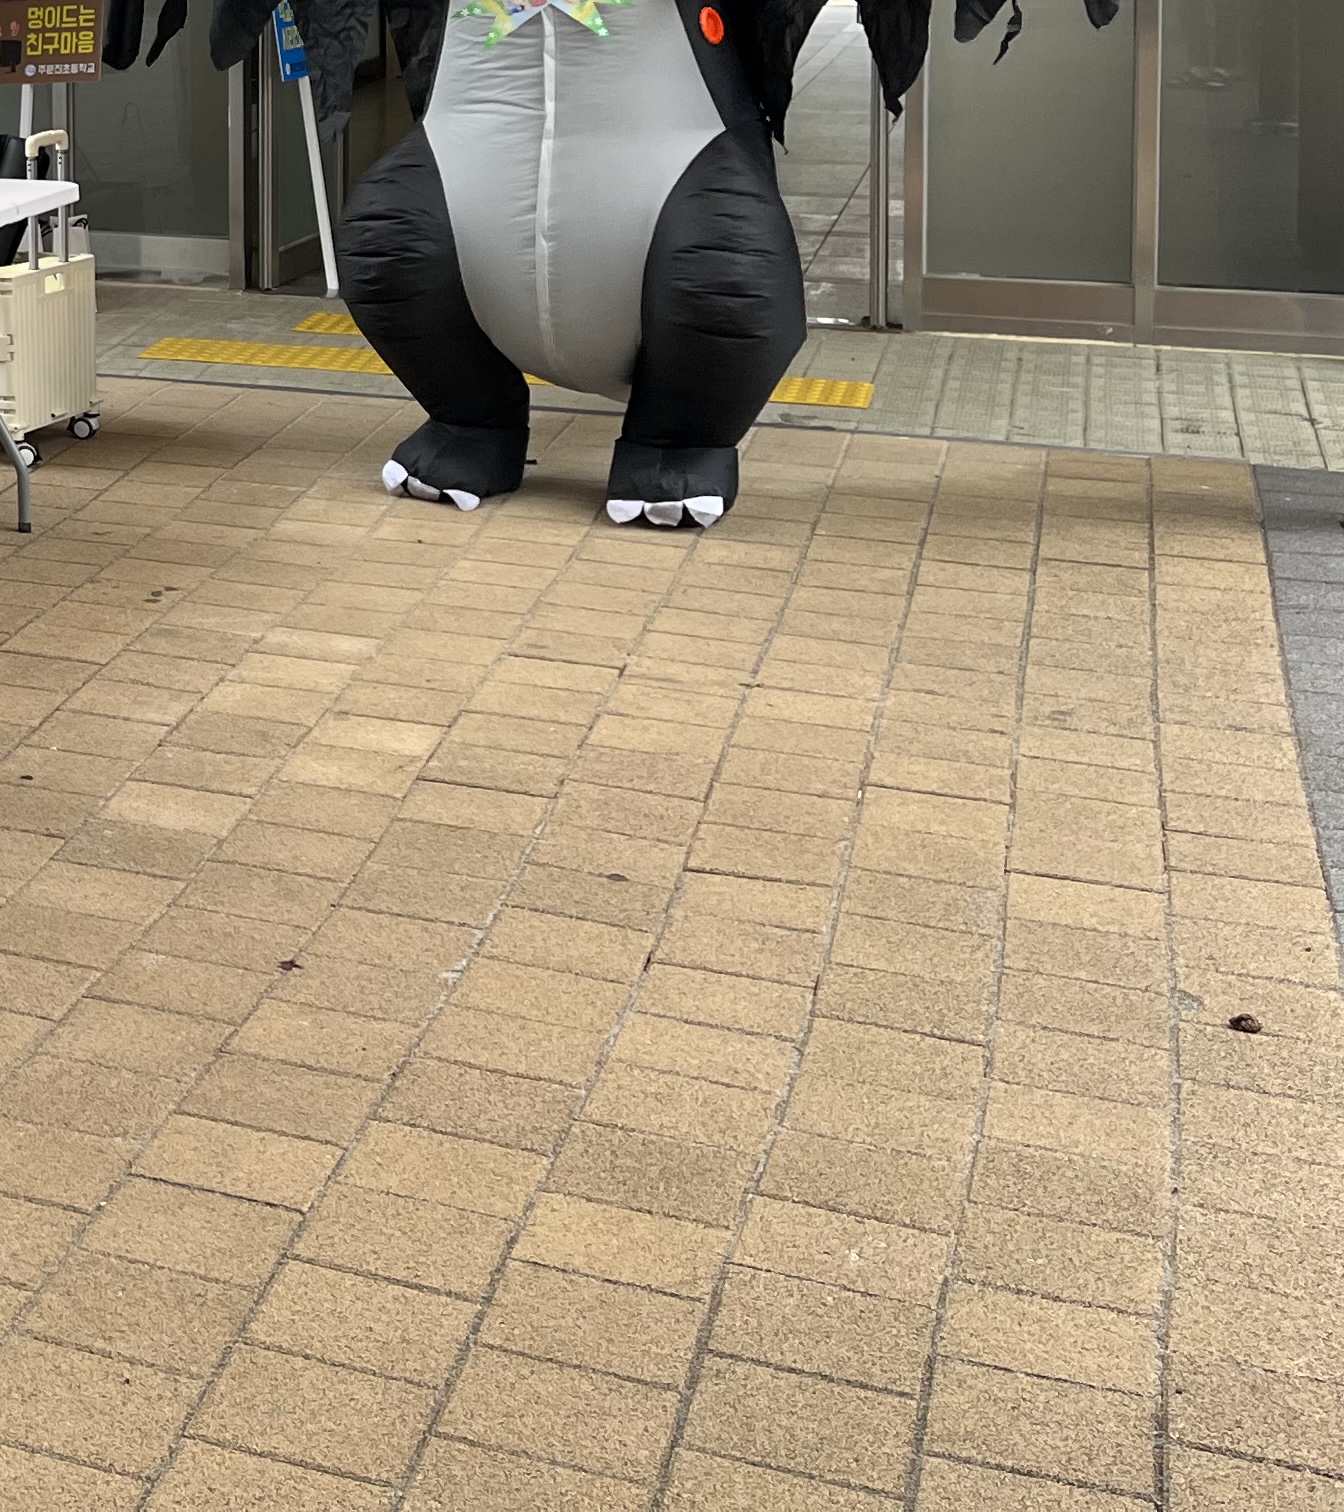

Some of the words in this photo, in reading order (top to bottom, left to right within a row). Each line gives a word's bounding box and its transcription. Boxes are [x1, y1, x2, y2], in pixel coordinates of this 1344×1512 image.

[27, 4, 96, 30] 멍이드는
[26, 31, 95, 57] 친구마음
[37, 63, 96, 76] 주문진초등학교
